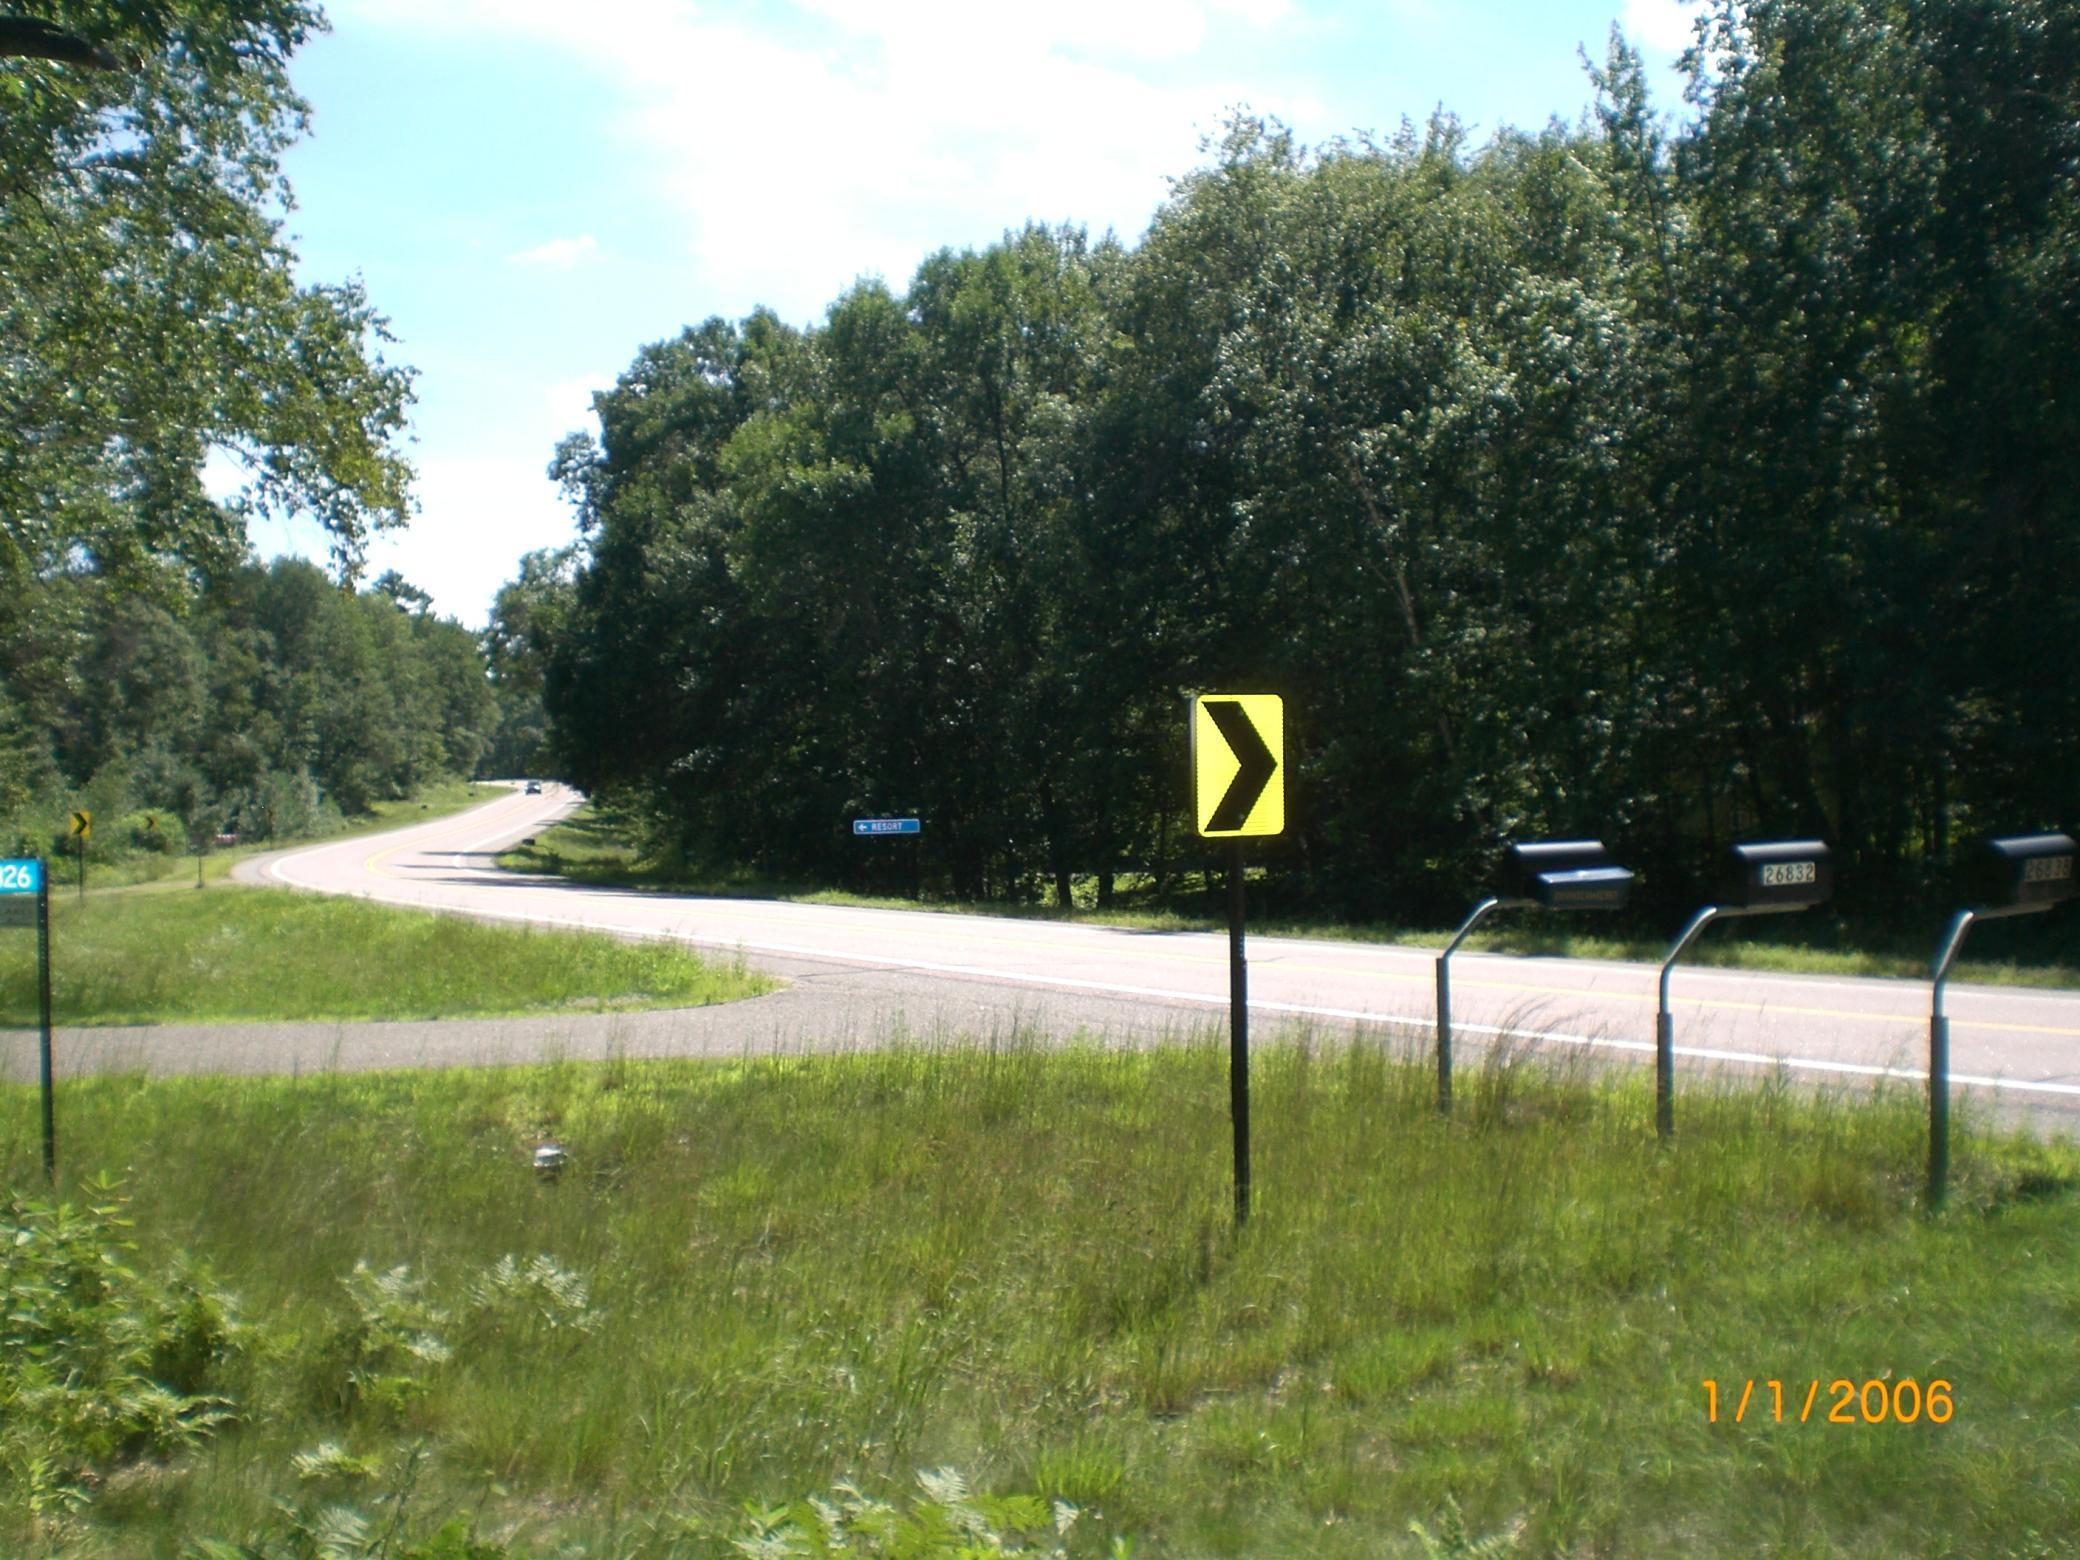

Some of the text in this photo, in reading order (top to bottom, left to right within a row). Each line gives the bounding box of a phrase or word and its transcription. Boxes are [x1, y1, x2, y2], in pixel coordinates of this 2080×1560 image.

[871, 822, 902, 831] RESORT
[0, 864, 31, 888] 26
[1765, 863, 1814, 884] 26832
